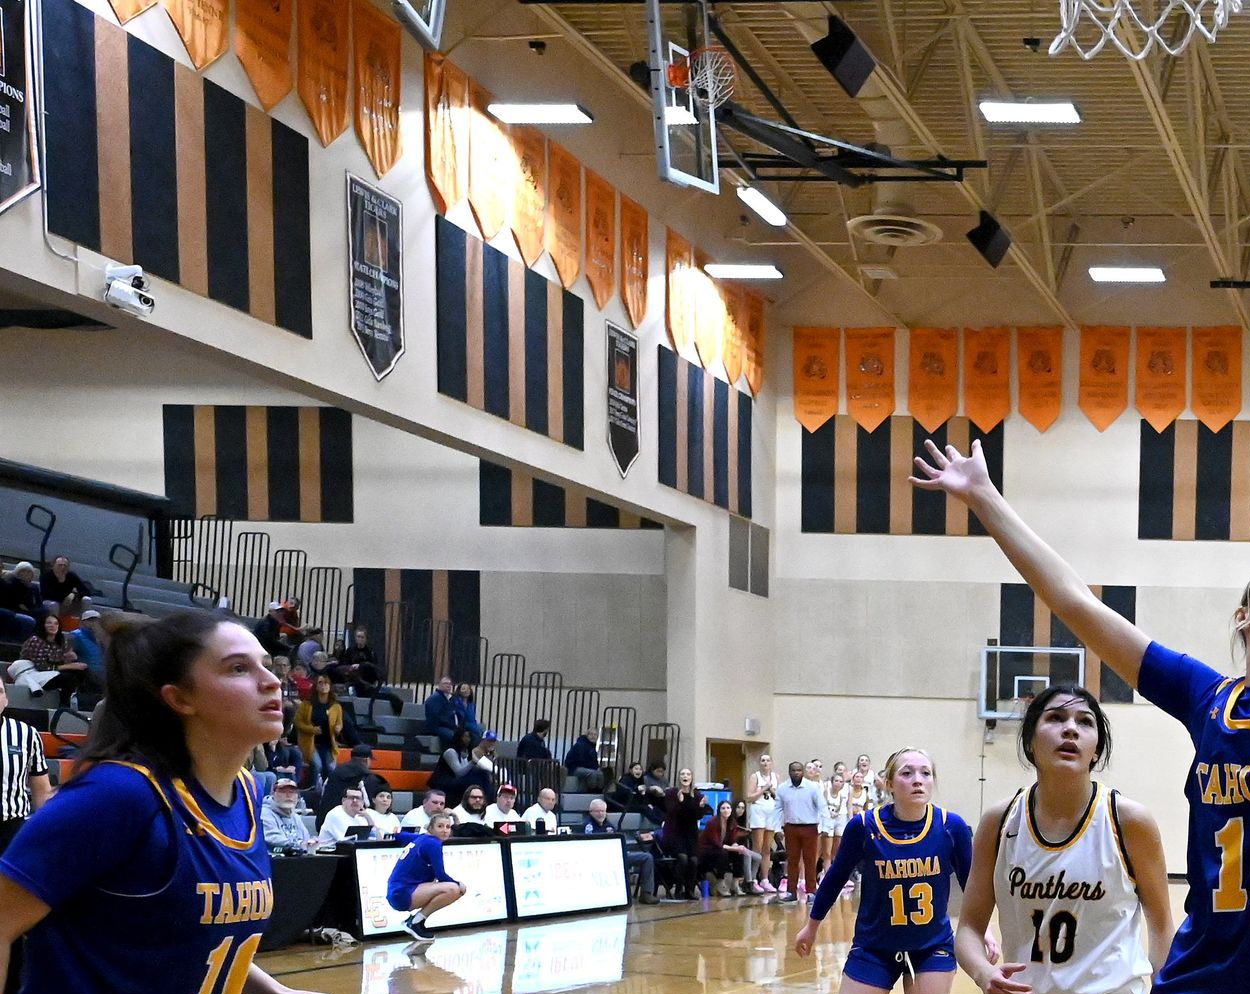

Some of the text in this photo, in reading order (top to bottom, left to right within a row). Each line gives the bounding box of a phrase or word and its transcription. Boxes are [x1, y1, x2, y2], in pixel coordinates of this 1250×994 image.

[874, 856, 941, 879] TAHOMA
[1009, 866, 1106, 901] Panthers
[196, 878, 274, 924] TAHOM
[888, 882, 934, 926] 13
[1030, 908, 1077, 964] 10
